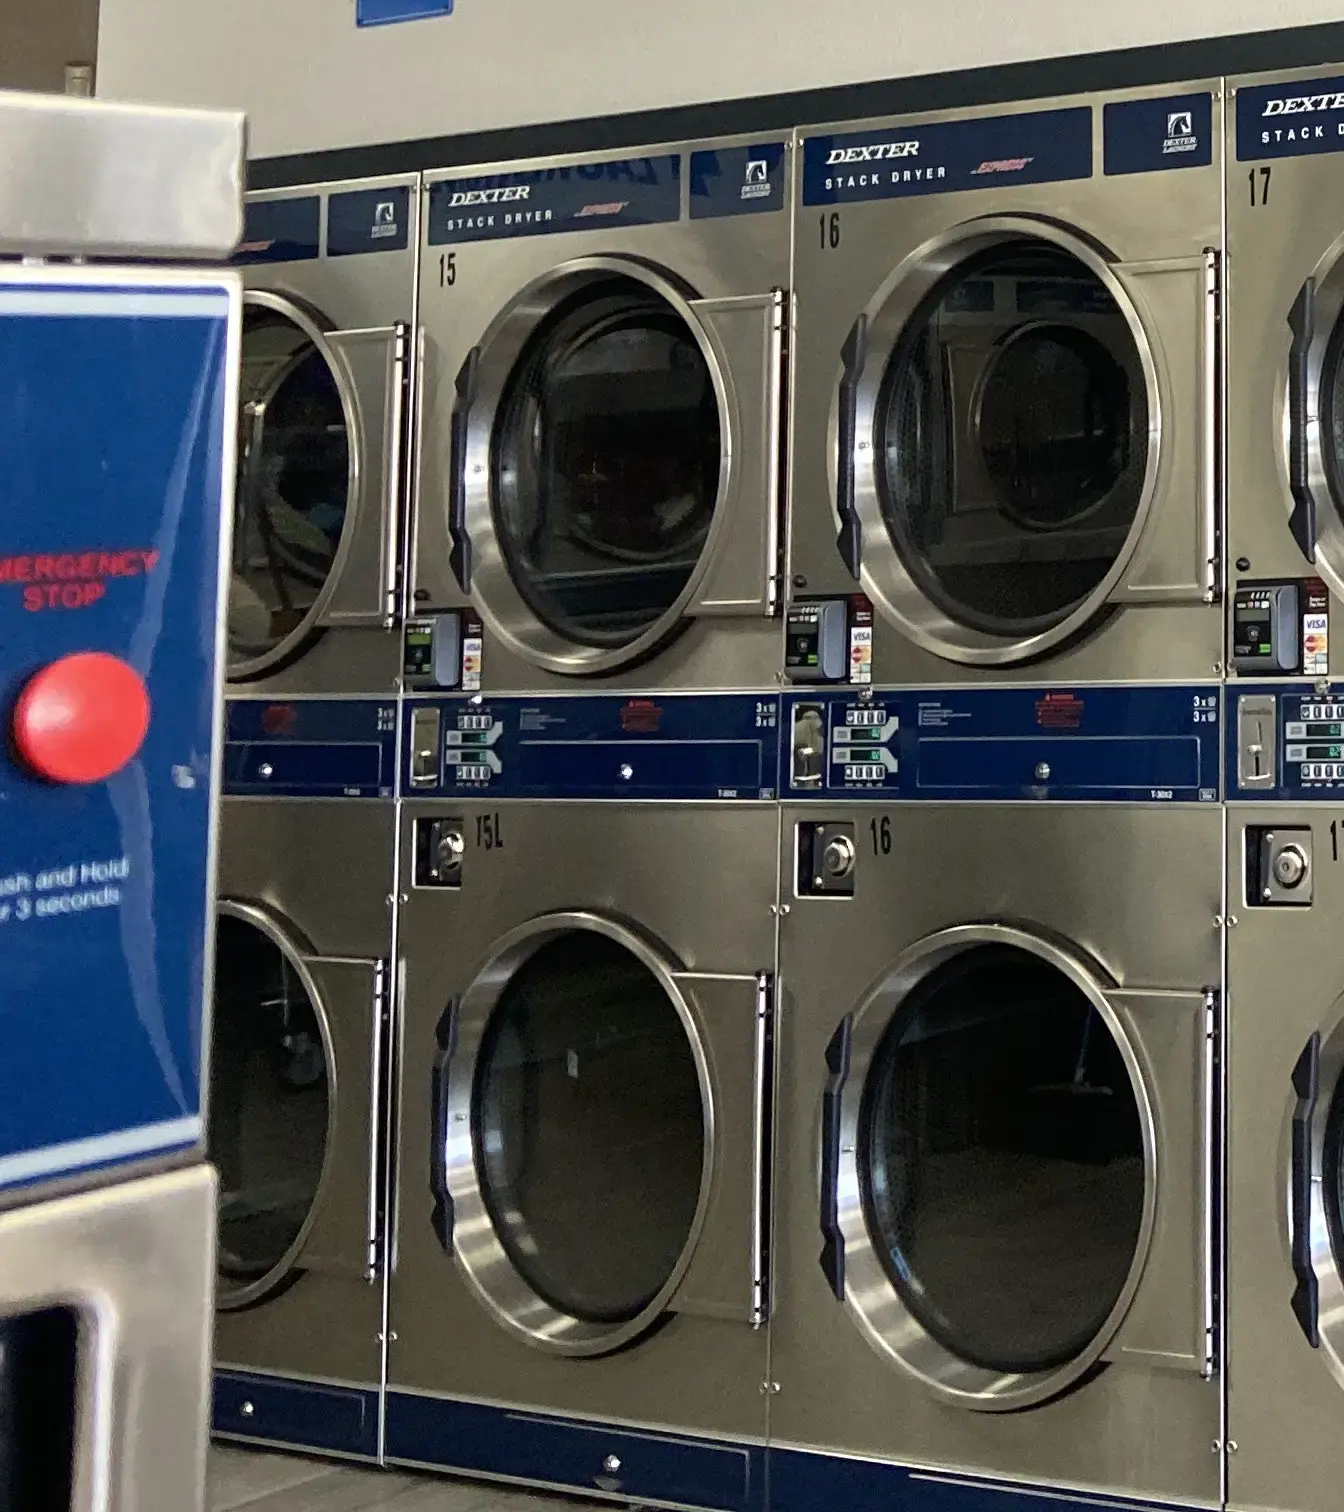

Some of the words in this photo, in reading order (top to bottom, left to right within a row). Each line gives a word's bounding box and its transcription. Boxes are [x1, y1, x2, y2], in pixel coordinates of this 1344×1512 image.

[1261, 125, 1324, 144] STACK
[826, 141, 920, 165] DEXTER
[825, 173, 880, 190] STACK
[891, 166, 946, 183] DRYER
[1248, 166, 1271, 207] 17
[448, 185, 530, 207] DEXTER
[448, 215, 496, 231] STACK
[505, 209, 553, 225] DRYER
[819, 211, 840, 250] 16
[439, 252, 456, 288] 15
[24, 582, 105, 613] STOP
[1307, 619, 1327, 629] VISA
[1193, 696, 1200, 707] 3
[1193, 711, 1200, 723] 3
[869, 816, 892, 856] 16
[36, 865, 77, 891] and
[81, 858, 130, 884] Hold
[15, 897, 32, 921] 3
[35, 886, 120, 918] seconds
